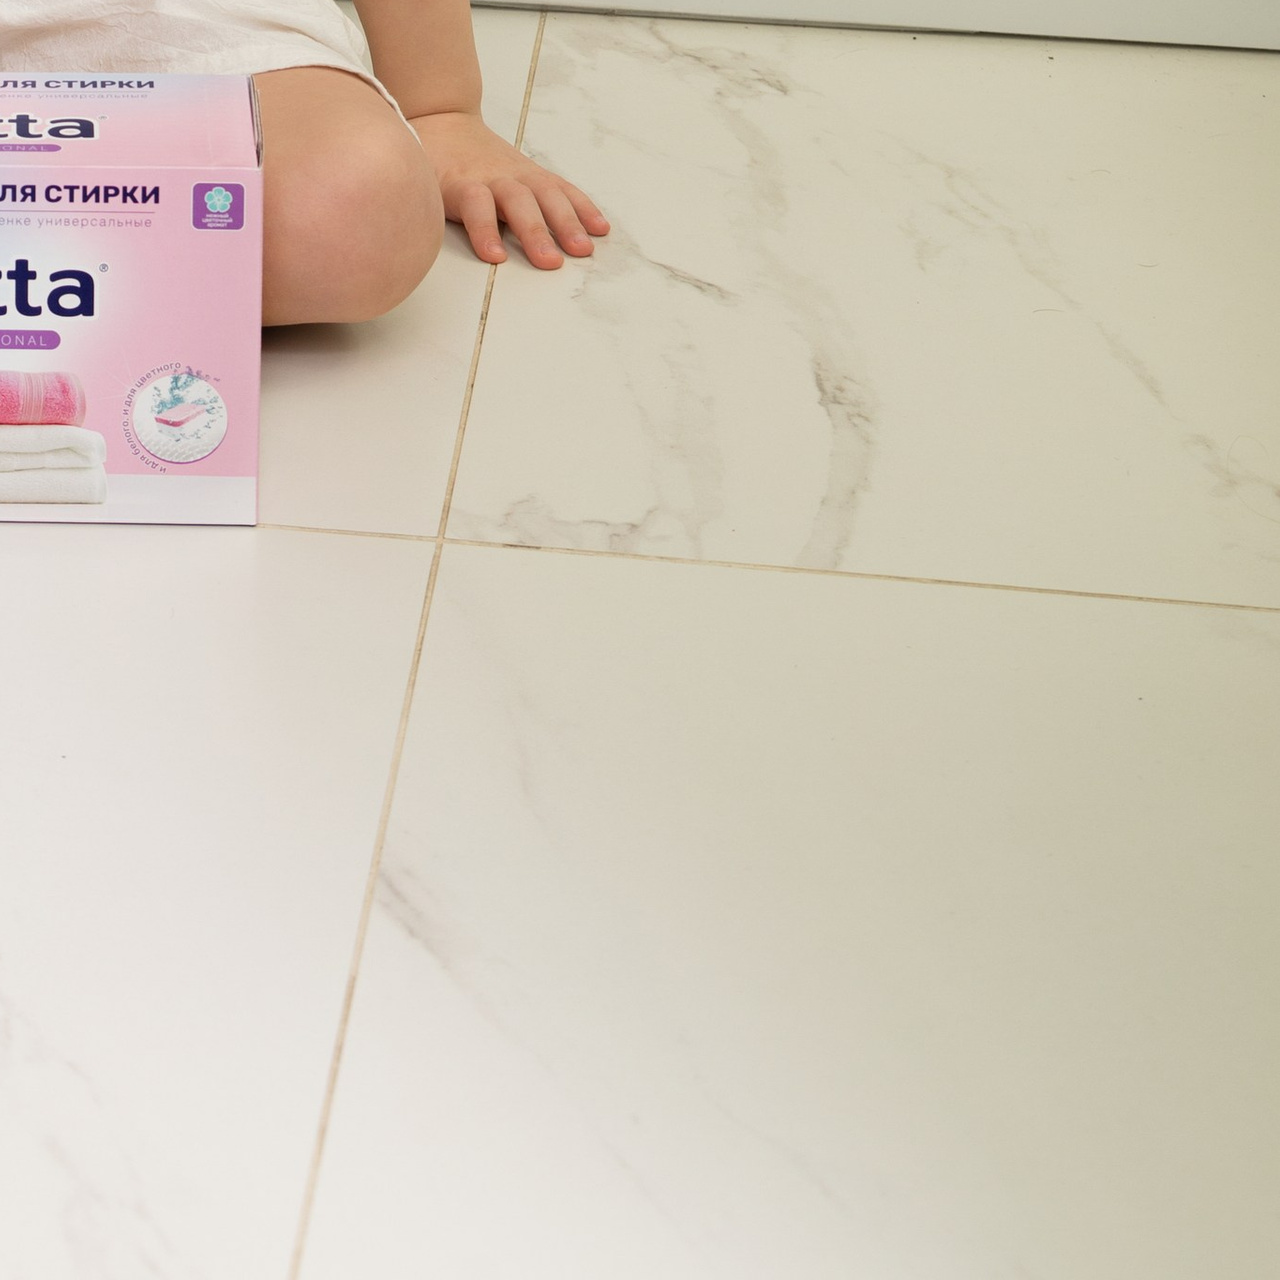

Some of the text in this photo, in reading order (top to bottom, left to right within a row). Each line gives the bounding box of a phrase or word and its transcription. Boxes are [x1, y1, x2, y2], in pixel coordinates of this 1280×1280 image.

[44, 80, 155, 89] СТИРКИ
[44, 185, 160, 204] СТИРКИ
[37, 219, 153, 229] универсальные
[135, 362, 182, 389] цветного
[126, 387, 137, 408] для
[140, 453, 159, 473] для
